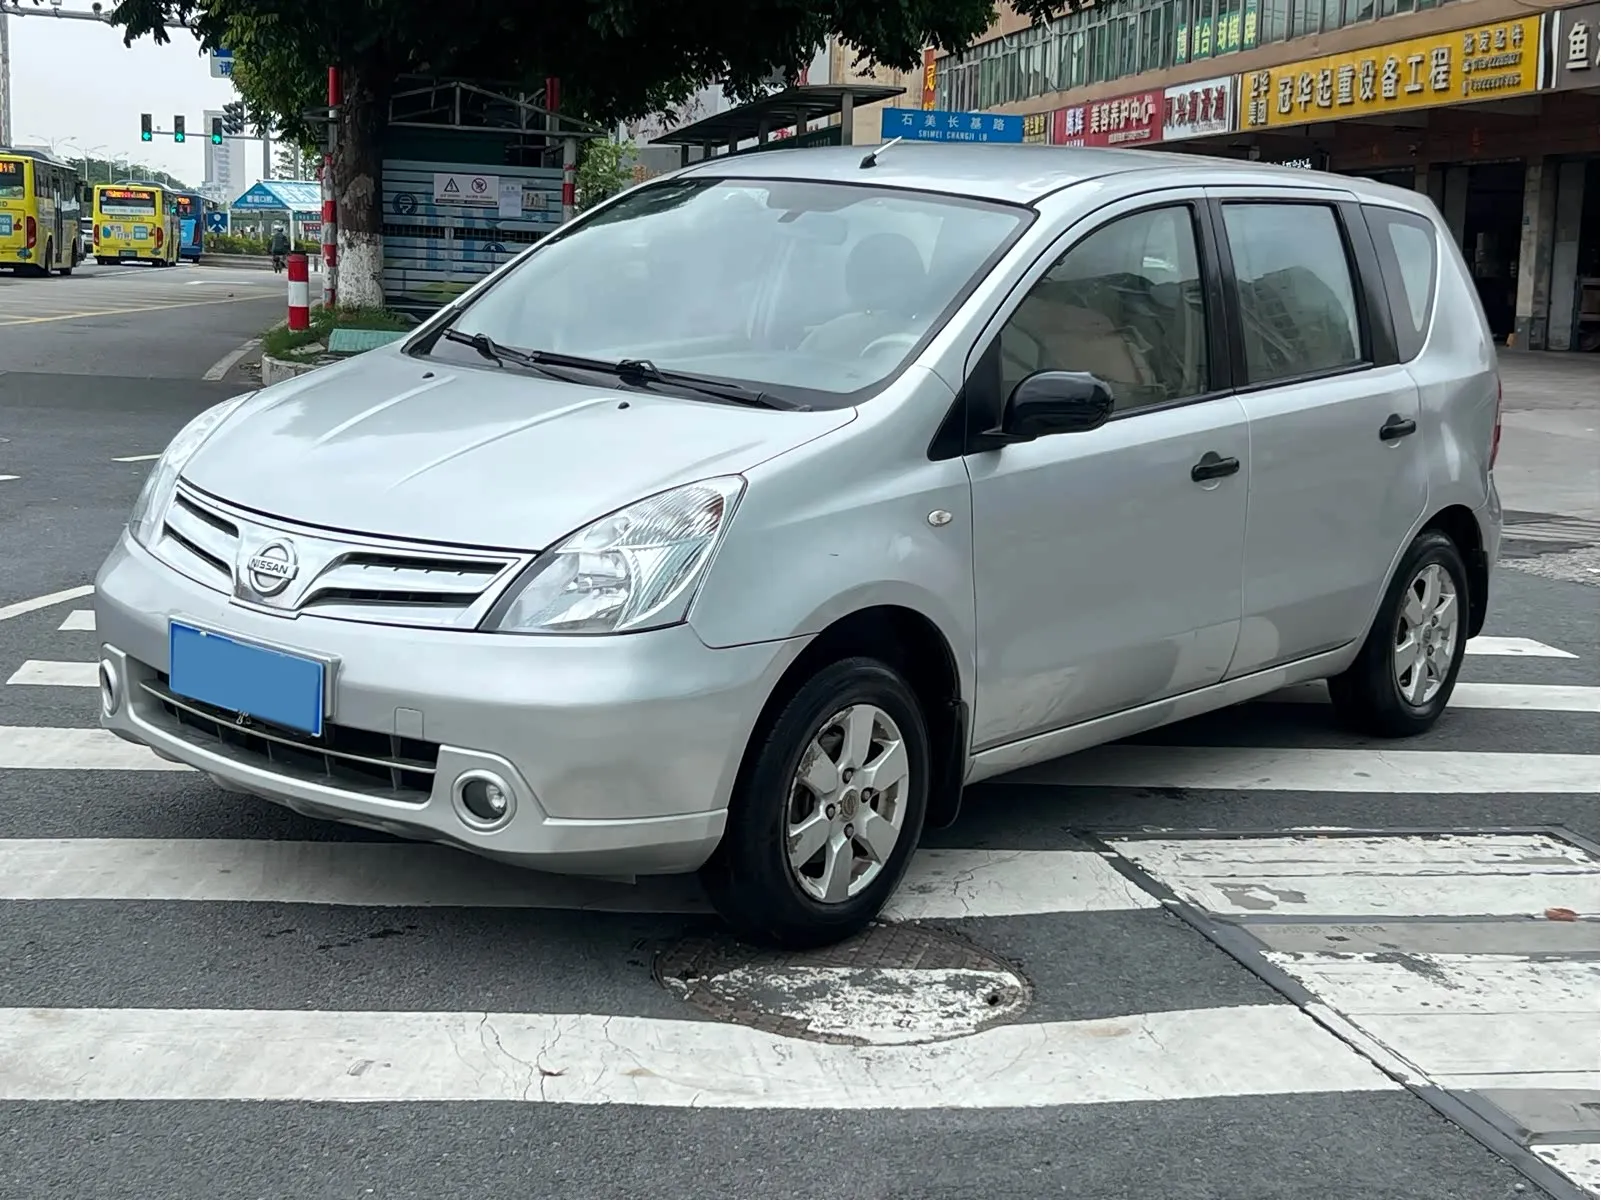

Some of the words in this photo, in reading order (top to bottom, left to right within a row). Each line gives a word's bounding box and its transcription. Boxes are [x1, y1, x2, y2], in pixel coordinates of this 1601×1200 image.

[1566, 22, 1600, 70] 鱼
[1277, 47, 1451, 113] 冠华起重设备工程
[901, 113, 1005, 131] 石美长基路
[1090, 95, 1156, 134] 美容养护中心
[946, 131, 975, 141] CHANGJI
[978, 132, 988, 141] LU
[251, 558, 289, 574] NISSAN
